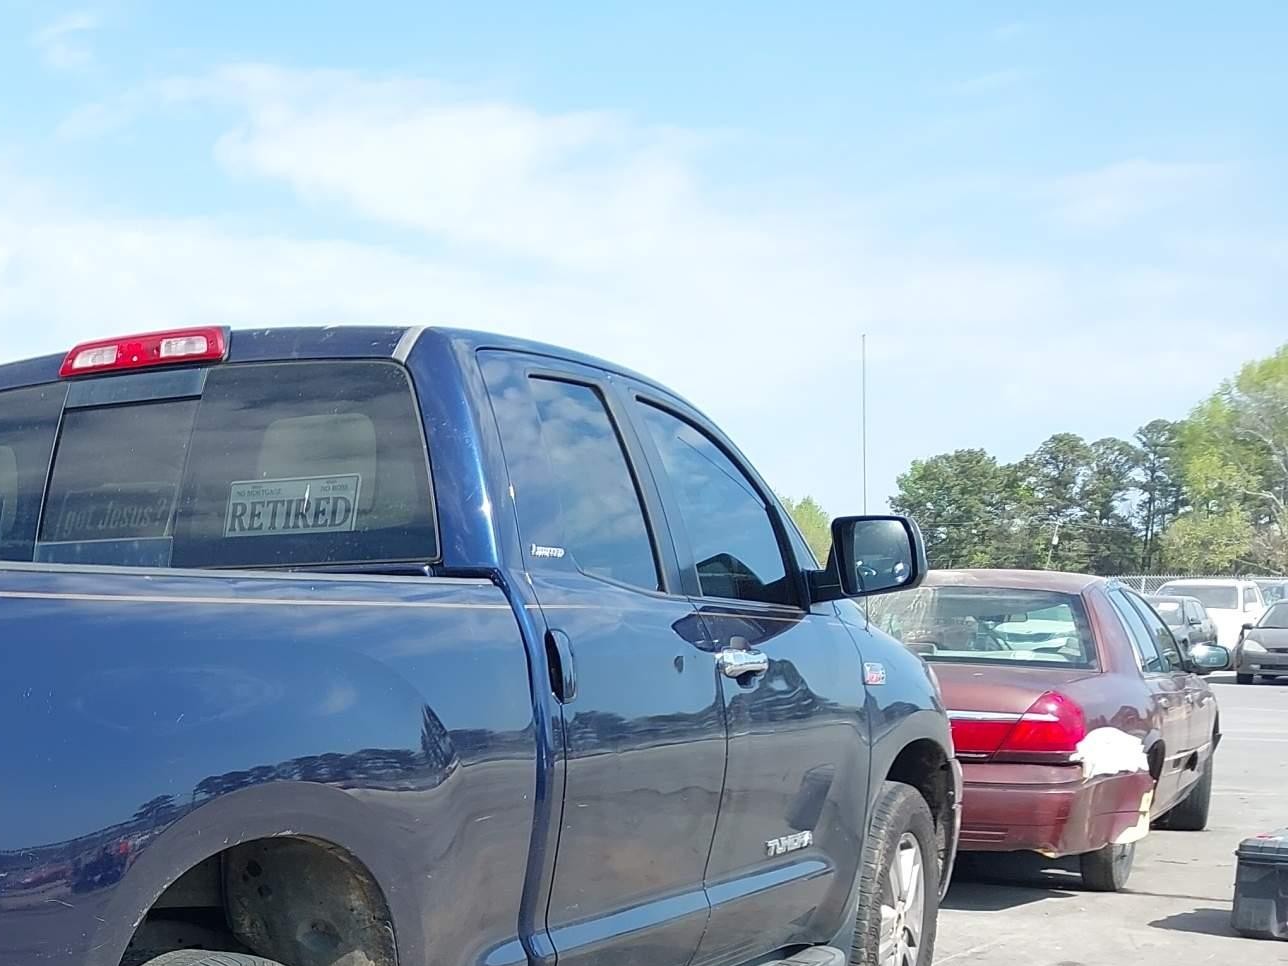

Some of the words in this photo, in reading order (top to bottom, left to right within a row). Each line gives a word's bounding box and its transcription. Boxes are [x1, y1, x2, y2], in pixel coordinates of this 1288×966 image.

[64, 505, 96, 538] got
[98, 498, 167, 530] Jesus?
[228, 496, 352, 532] RETIRED
[766, 830, 813, 856] TUNDRA
